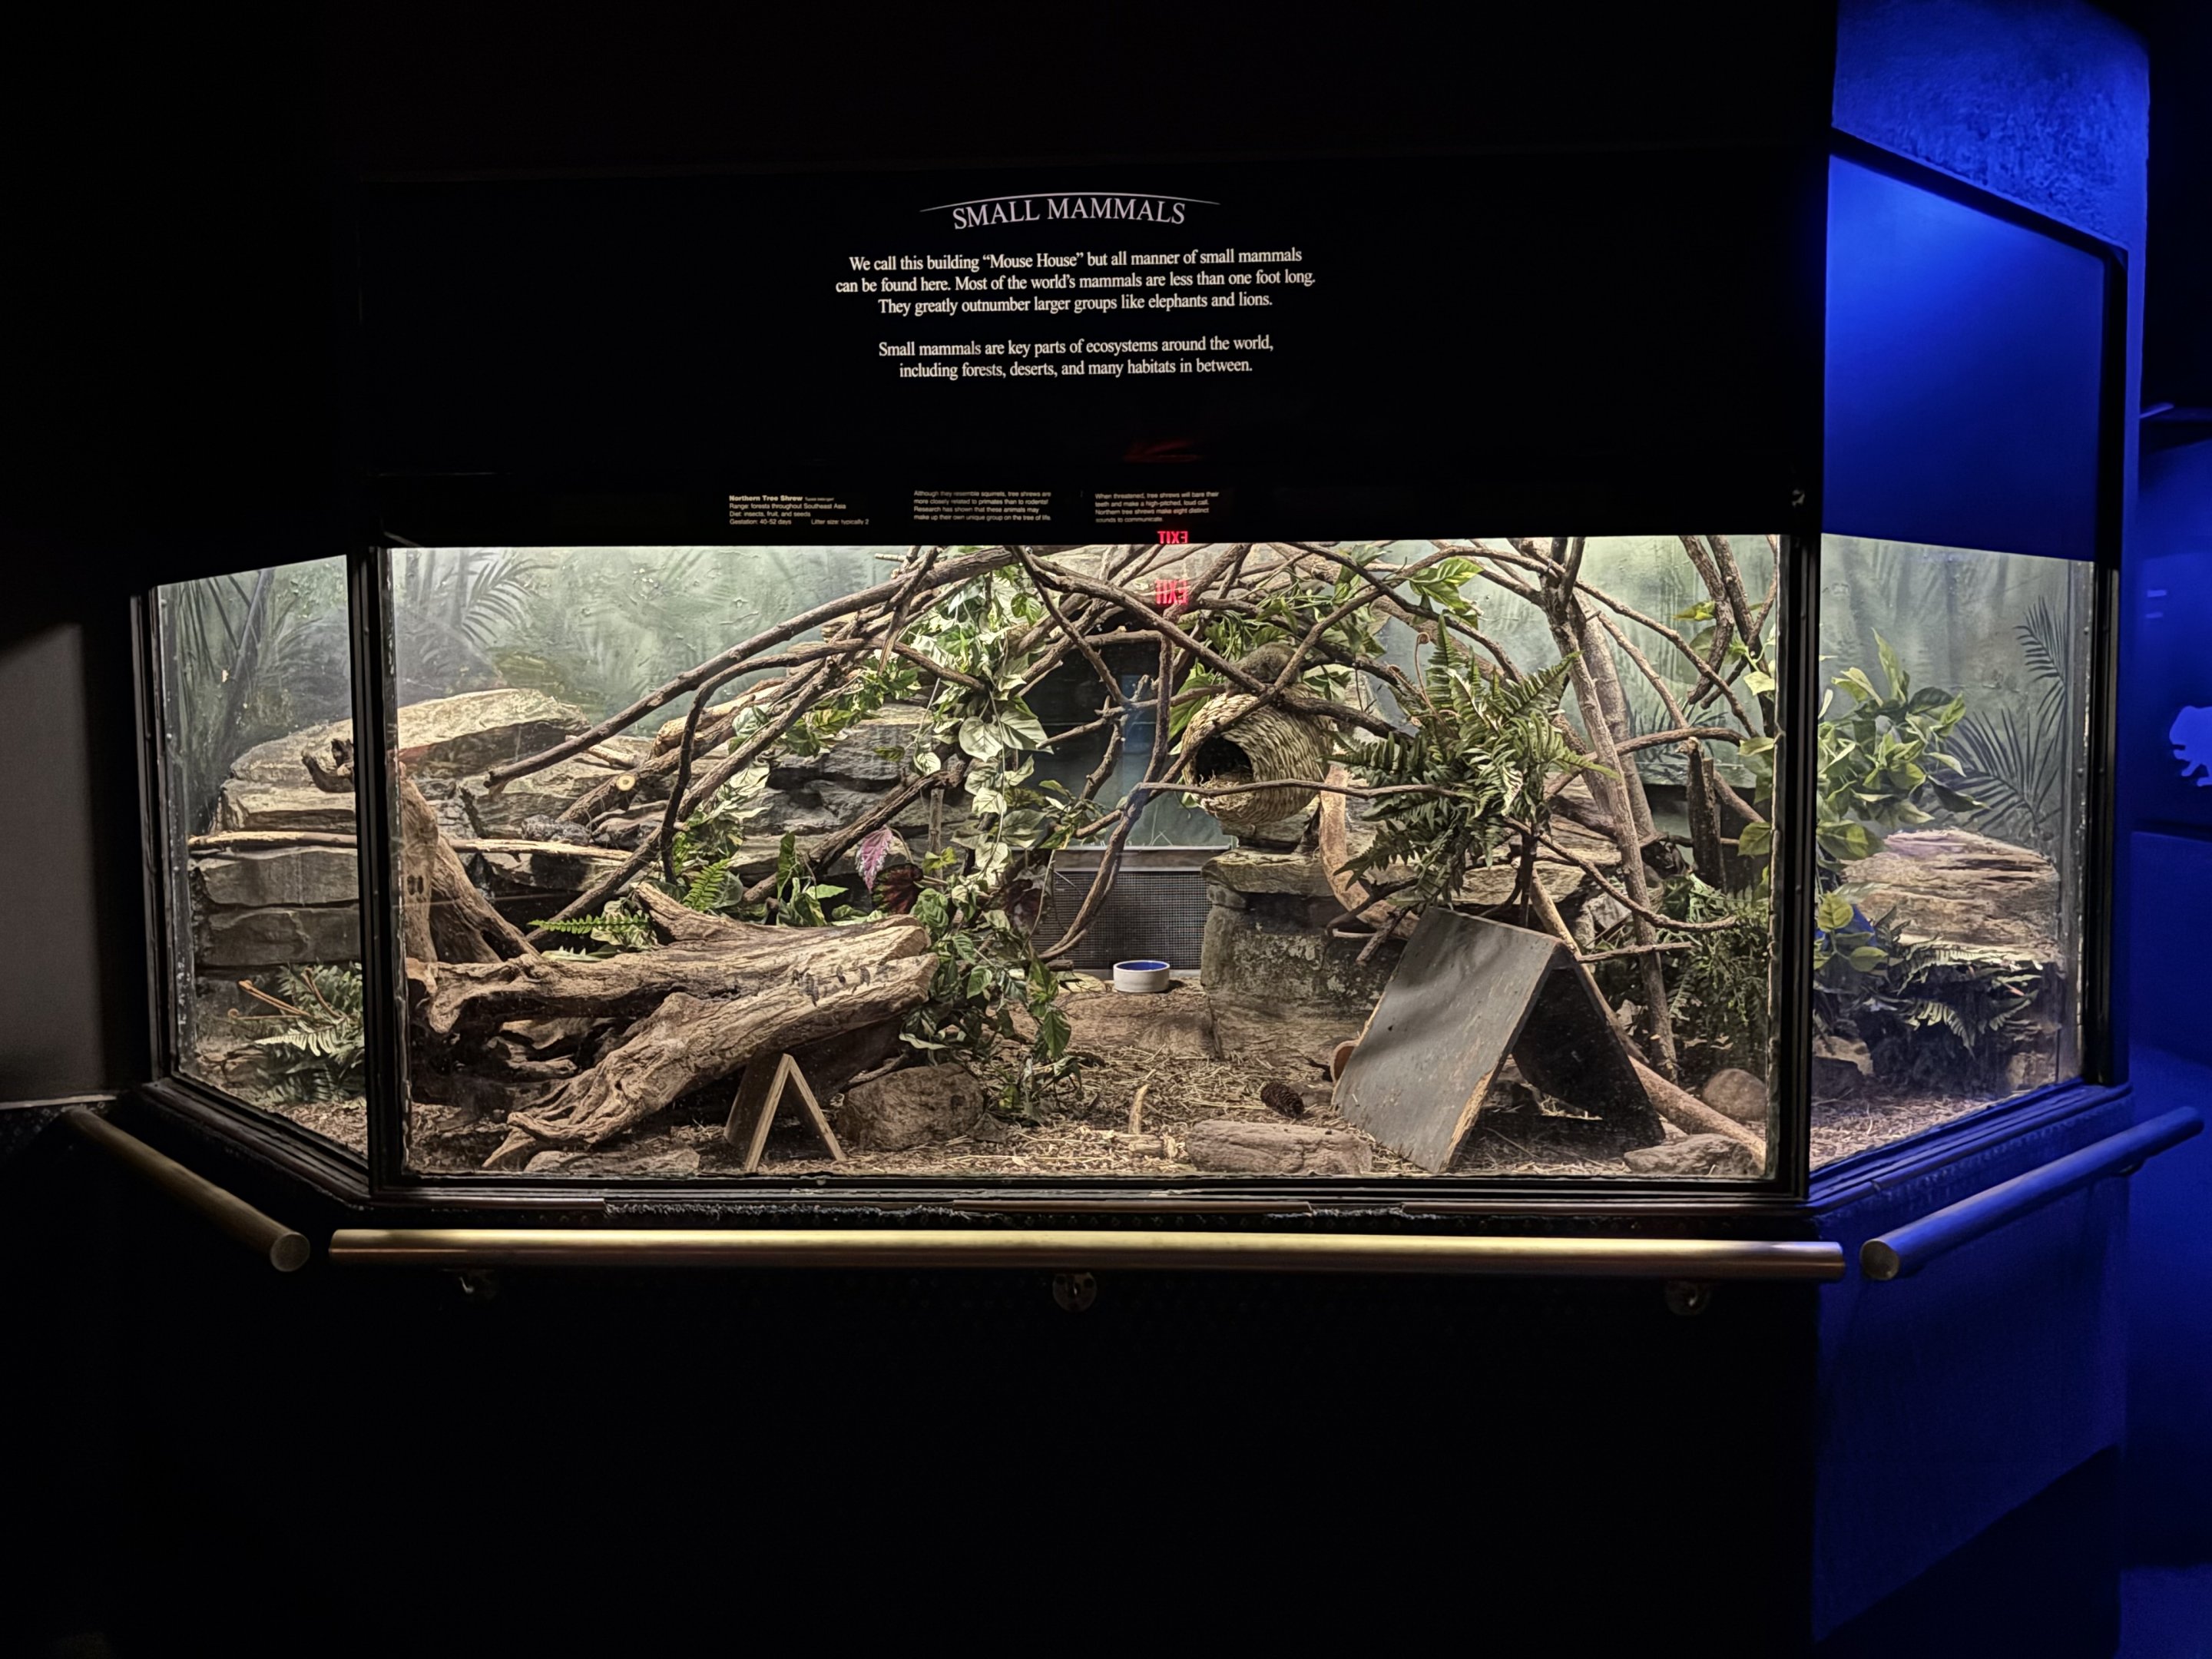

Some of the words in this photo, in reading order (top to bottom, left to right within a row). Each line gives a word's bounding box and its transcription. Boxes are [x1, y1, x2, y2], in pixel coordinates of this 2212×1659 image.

[952, 200, 1040, 230] SMALL
[1047, 197, 1186, 225] MAMMALS
[849, 257, 870, 270] We
[874, 256, 896, 270] call
[900, 256, 923, 270] this
[927, 255, 979, 272] building
[1088, 252, 1108, 266] but
[1111, 251, 1127, 265] all
[1131, 254, 1180, 265] manner
[1183, 250, 1198, 264] of
[1200, 249, 1234, 263] small
[1239, 247, 1302, 263] mammals
[836, 282, 858, 293] can
[862, 278, 877, 292] be
[881, 277, 917, 292] found
[921, 276, 951, 291] here.
[955, 275, 988, 290] Most
[991, 275, 1006, 290] of
[1008, 275, 1027, 290] the
[1031, 274, 1075, 289] world’s
[1080, 273, 1142, 287] mammals
[1146, 276, 1166, 286] are
[1171, 272, 1193, 286] less
[1197, 271, 1224, 285] than
[1229, 274, 1252, 284] one
[1257, 270, 1280, 283] foot
[1285, 269, 1315, 286] long.
[878, 299, 911, 316] They
[915, 298, 958, 316] greatly
[962, 296, 1031, 312] outnumber
[1035, 296, 1071, 314] larger
[1074, 299, 1117, 313] groups
[1121, 294, 1144, 308] like
[1148, 293, 1207, 311] elephants
[1211, 292, 1235, 306] and
[1240, 292, 1272, 306] lions.
[879, 342, 915, 356] Small
[919, 341, 981, 356] mammals
[985, 345, 1005, 354] are
[1008, 340, 1031, 358] key
[1035, 342, 1066, 357] parts
[1070, 339, 1084, 353] of
[1086, 340, 1158, 356] ecosystems
[1162, 336, 1206, 351] around
[1210, 336, 1230, 349] the
[1233, 335, 1273, 351] world,
[900, 363, 958, 380] including
[962, 363, 1006, 378] forests,
[1010, 362, 1057, 377] deserts,
[1061, 360, 1084, 375] and
[1088, 364, 1124, 377] many
[1128, 359, 1176, 373] habitats
[1181, 358, 1192, 373] in
[1197, 358, 1252, 373] between.
[770, 502, 802, 511] throughout
